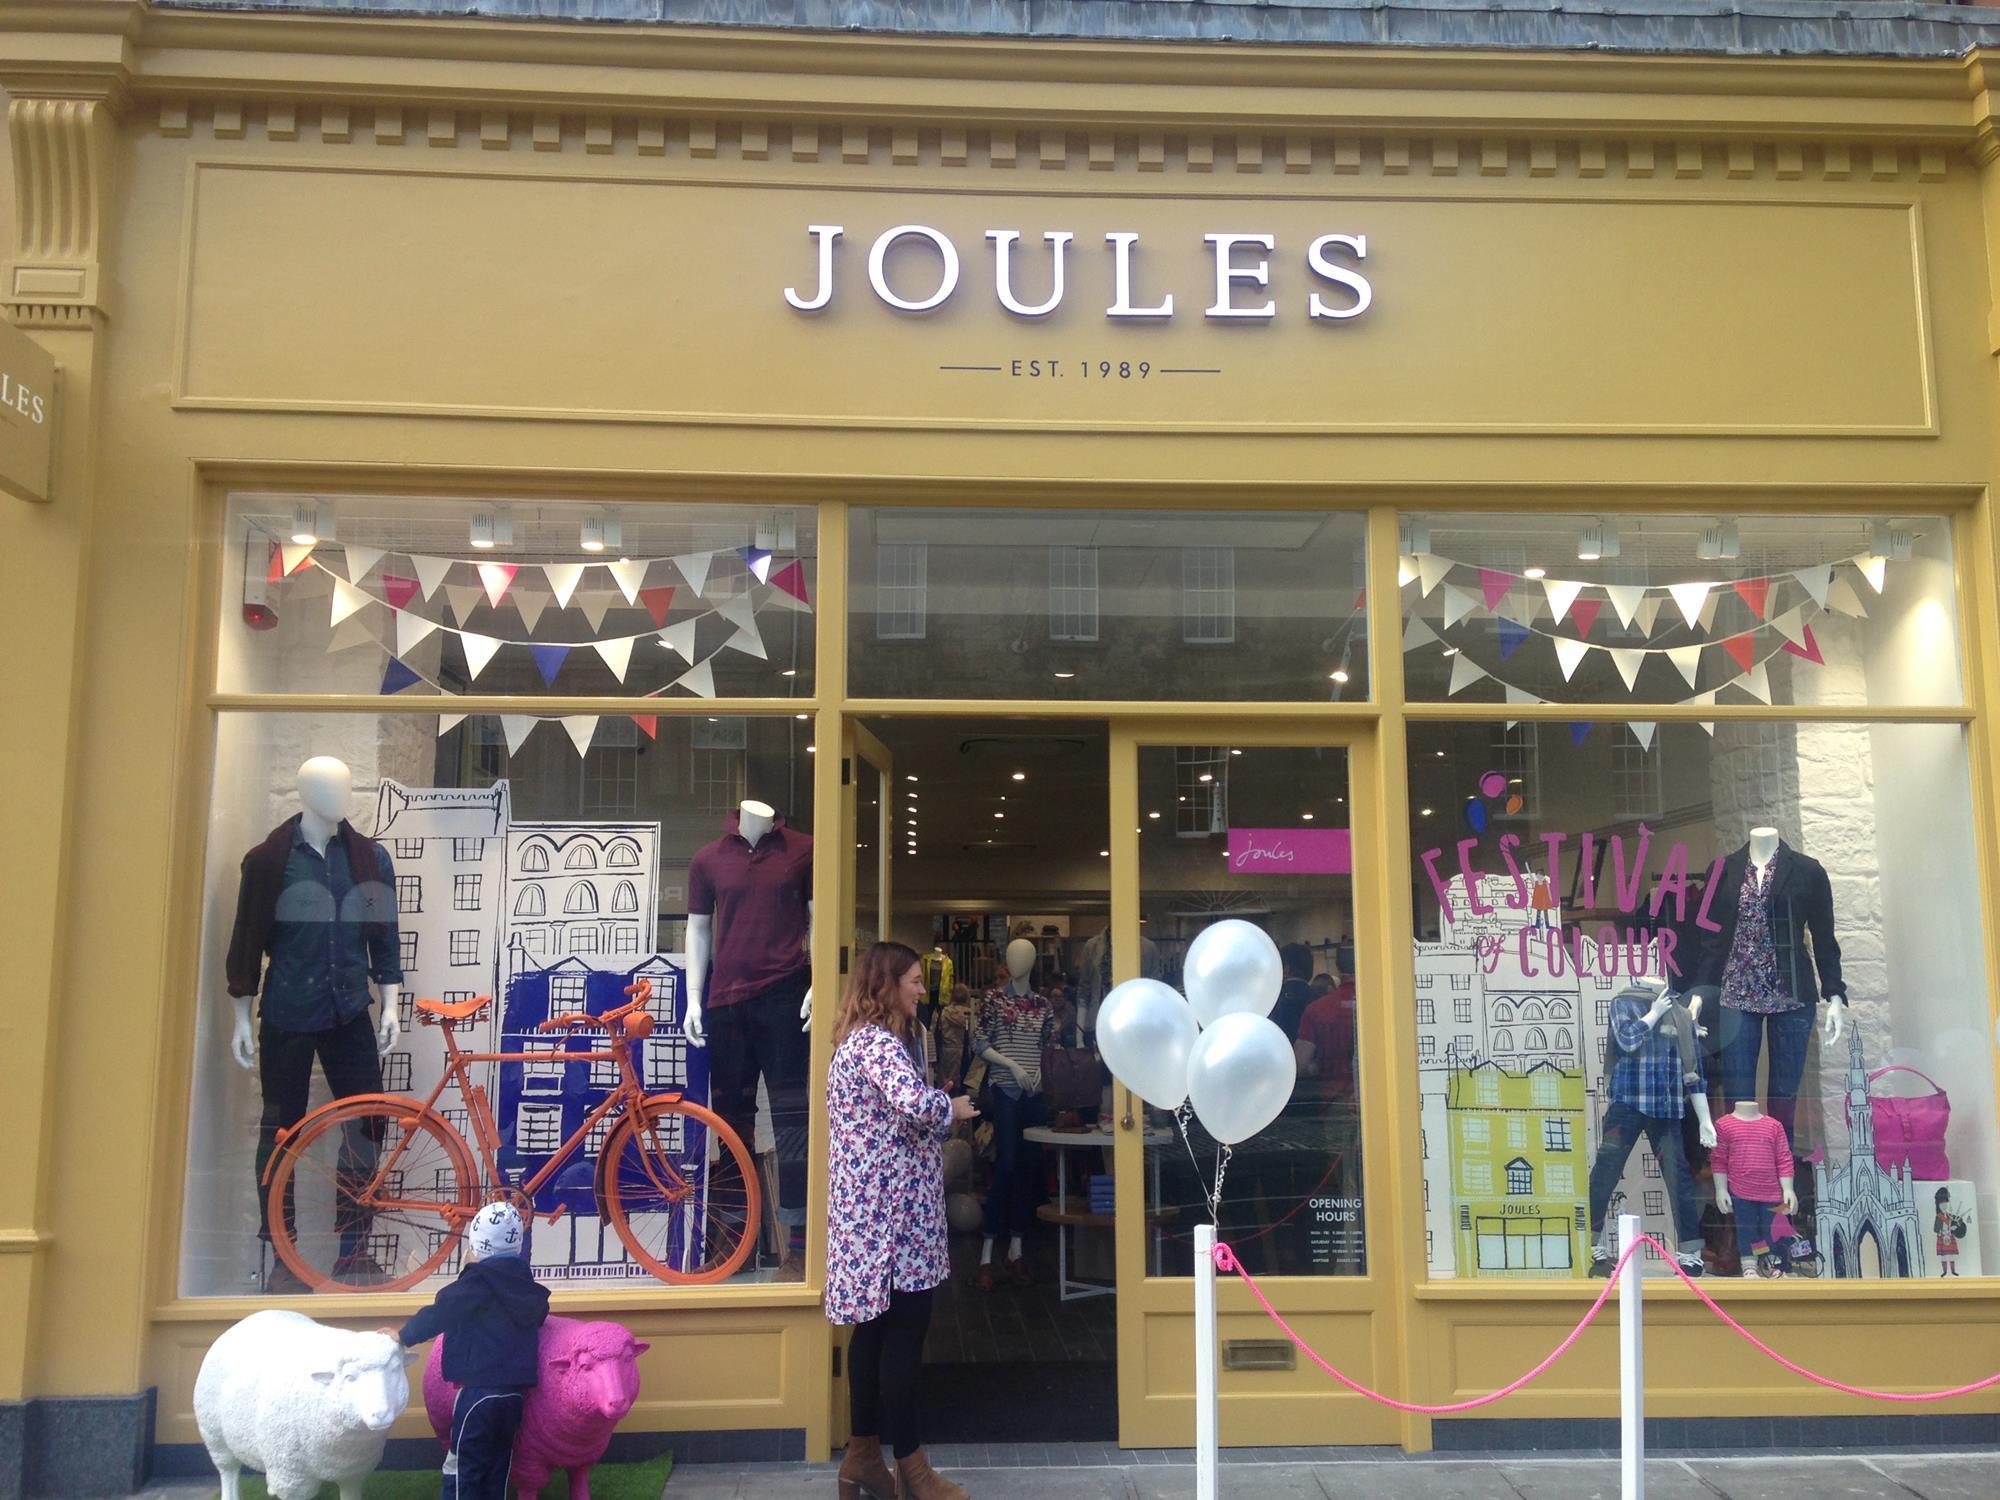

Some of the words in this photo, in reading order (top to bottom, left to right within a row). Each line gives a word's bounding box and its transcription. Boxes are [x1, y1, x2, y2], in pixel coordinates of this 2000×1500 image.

[783, 224, 1373, 319] JOULES
[1011, 360, 1064, 377] EST.
[1081, 361, 1152, 379] 1989
[1420, 831, 1725, 933] FESTIVAL
[1519, 925, 1683, 978] COLOUR
[1308, 1198, 1362, 1209] OPENING
[1499, 1203, 1541, 1215] JOULES
[1316, 1211, 1356, 1222] HOURS
